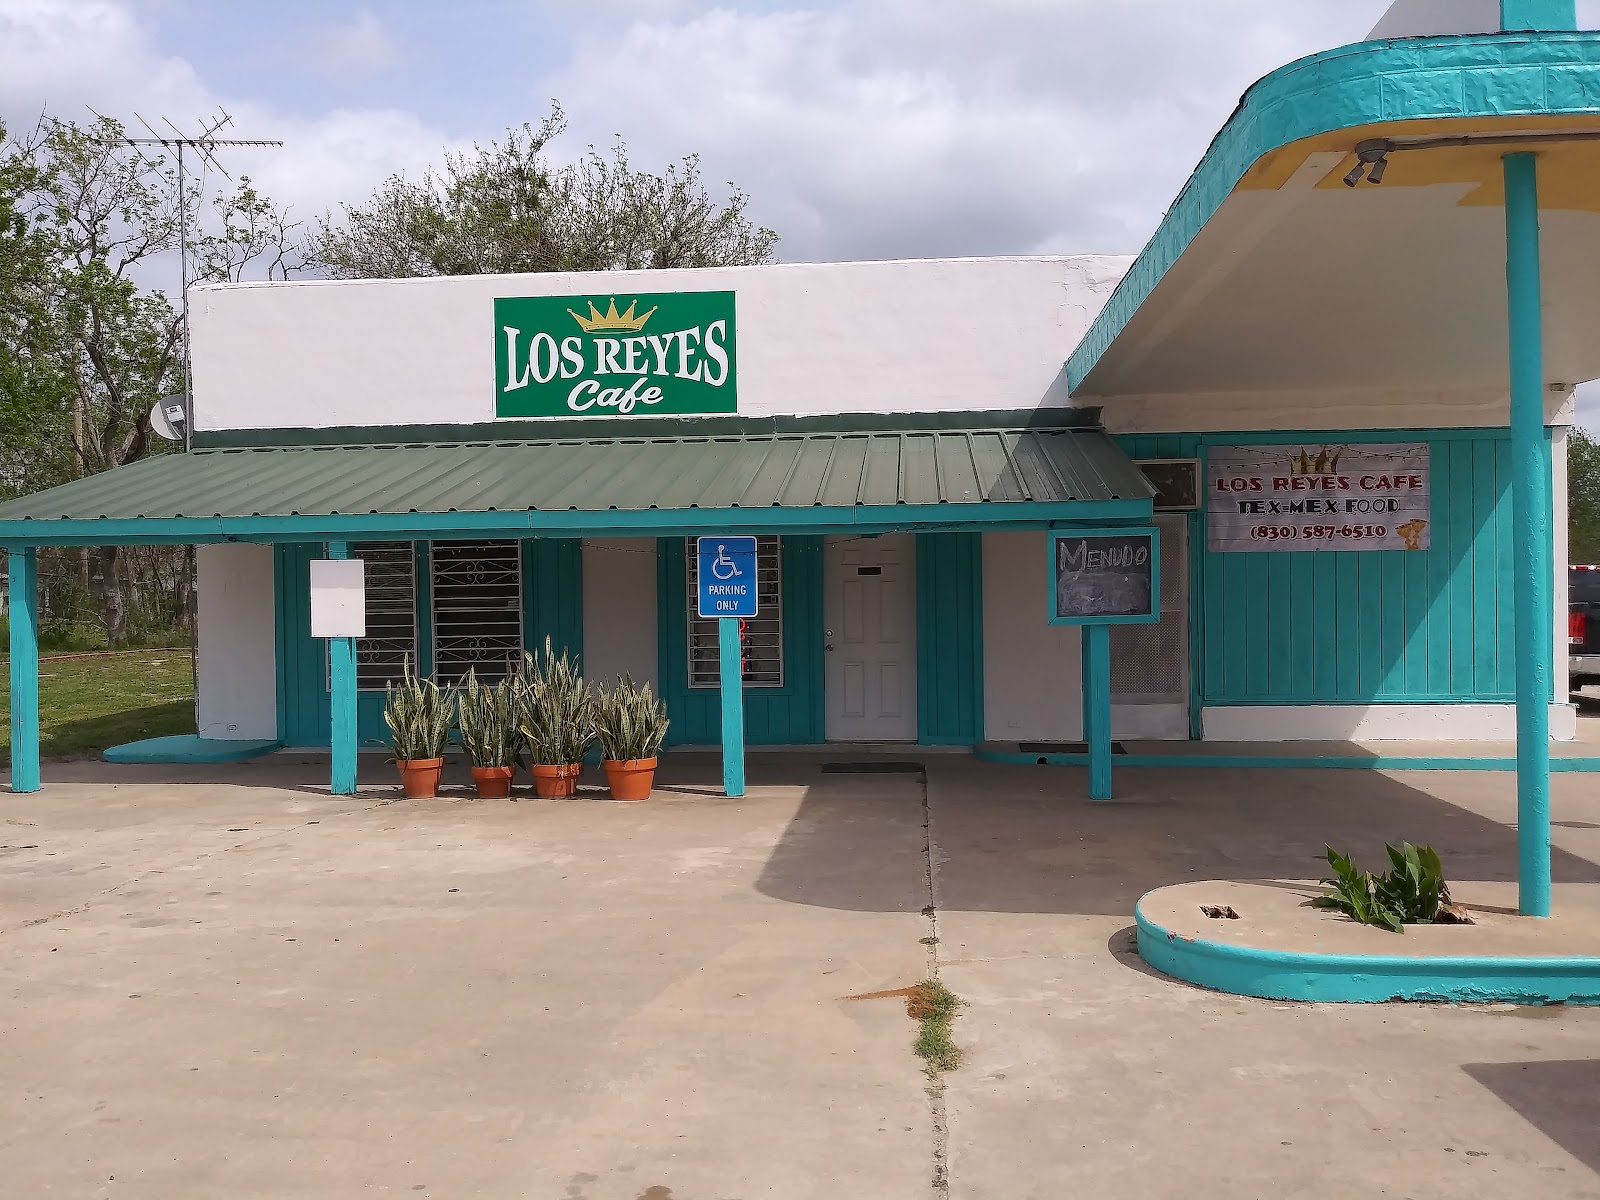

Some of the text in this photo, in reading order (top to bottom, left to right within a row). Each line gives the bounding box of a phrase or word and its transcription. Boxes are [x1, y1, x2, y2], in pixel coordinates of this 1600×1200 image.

[503, 319, 729, 393] LOS REYES
[567, 377, 664, 414] Cafe
[1216, 474, 1423, 492] LOS REYES CAFE
[1237, 498, 1400, 514] TEX-MEX FOOD
[1250, 525, 1387, 540] (830) 587-6510
[708, 585, 747, 596] PARKING
[716, 600, 739, 611] ONLY
